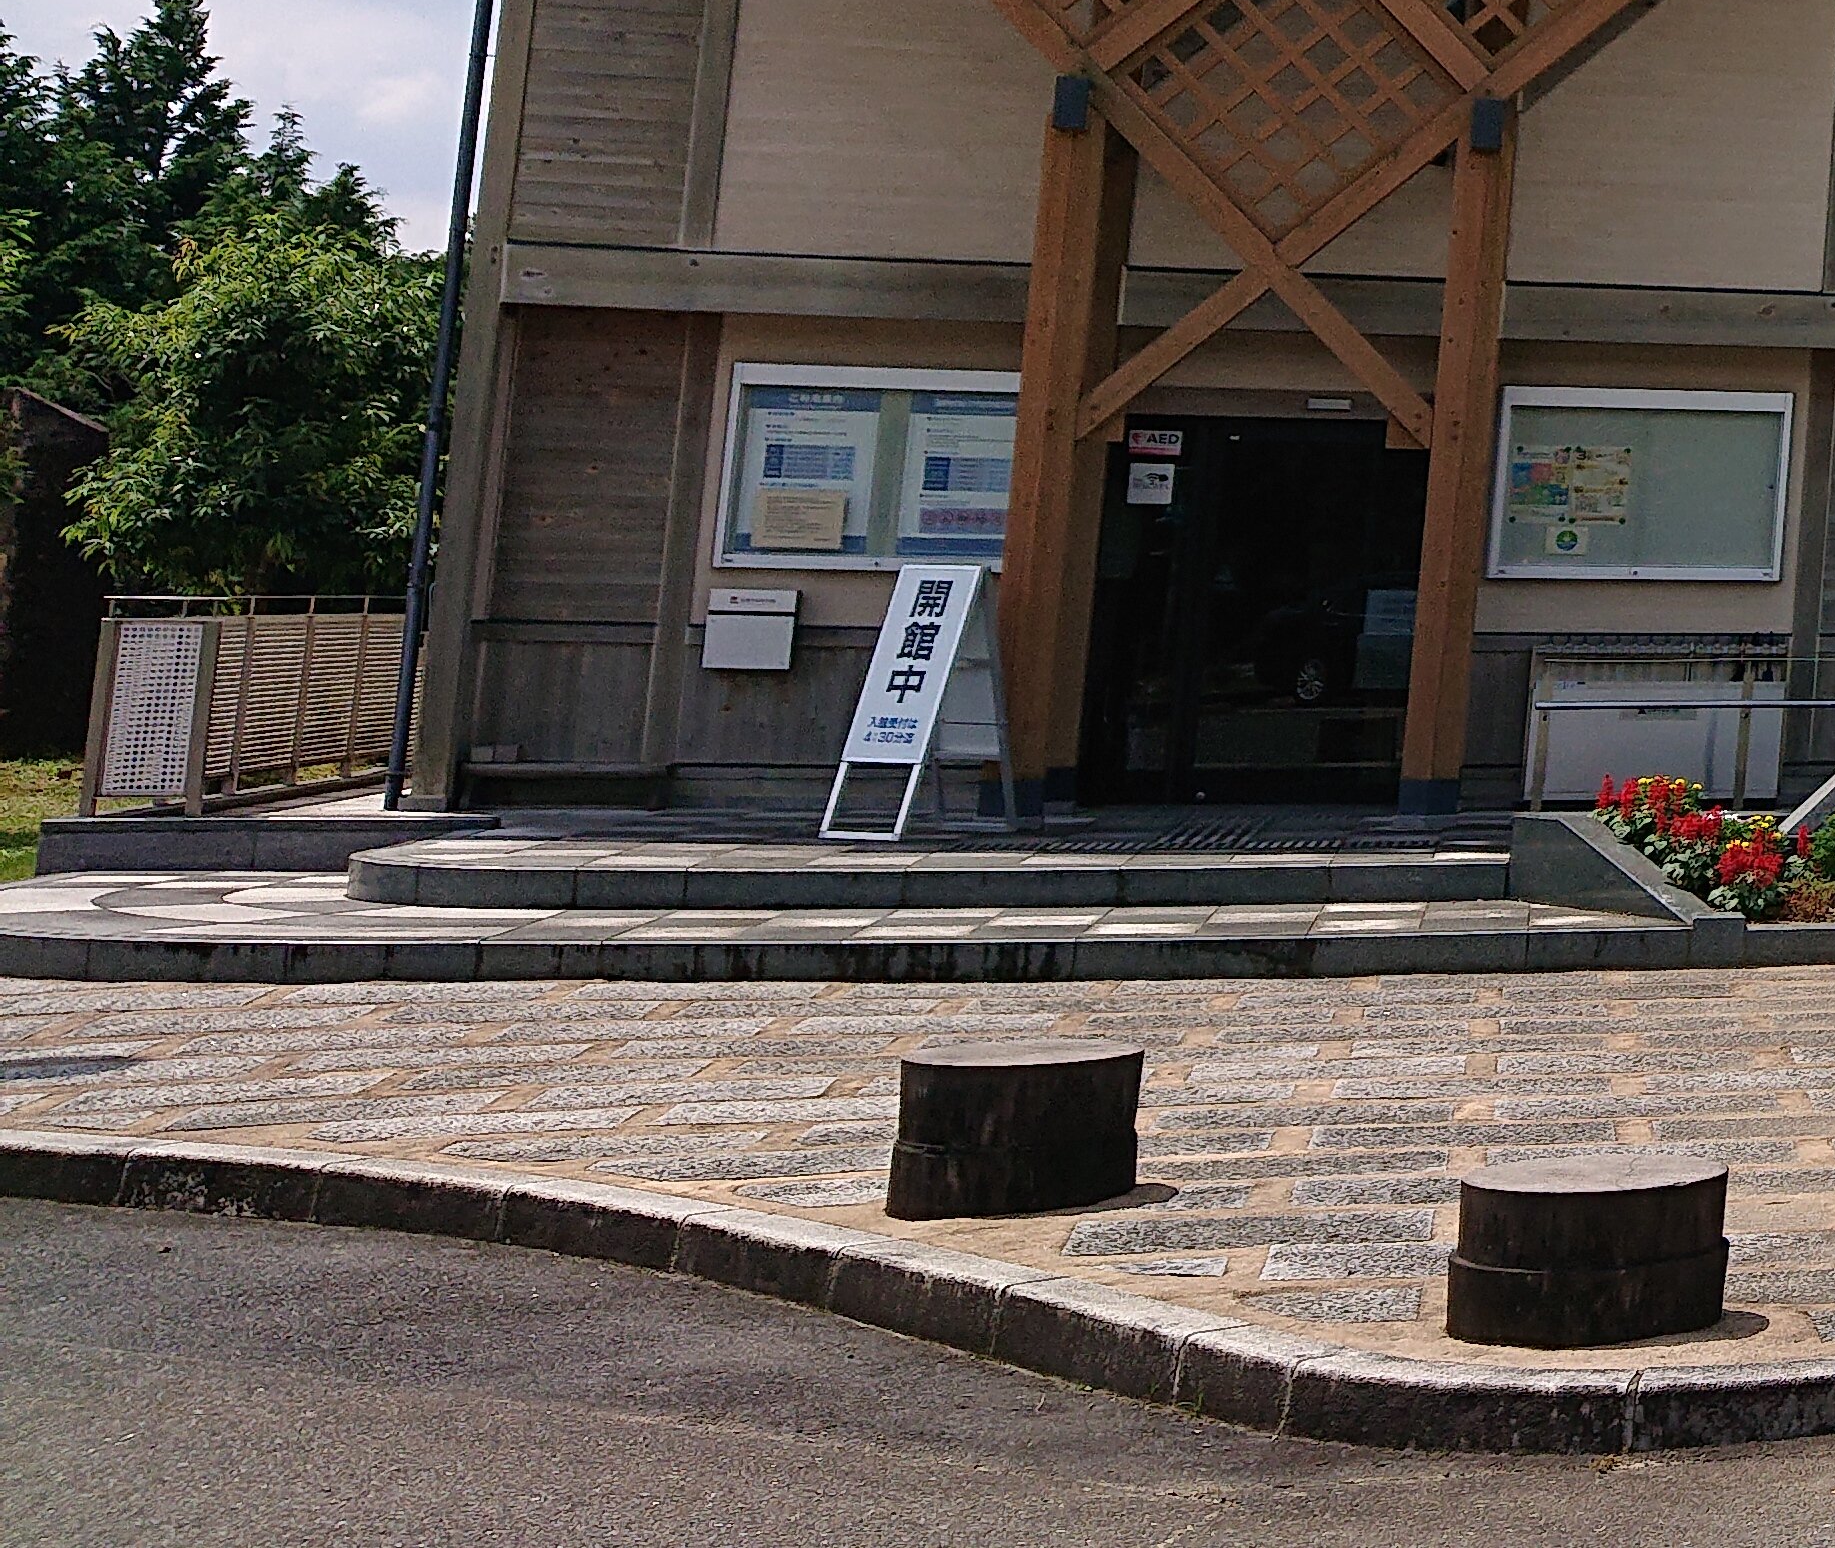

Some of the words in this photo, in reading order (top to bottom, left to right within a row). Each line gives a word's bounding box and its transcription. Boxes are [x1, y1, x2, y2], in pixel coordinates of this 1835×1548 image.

[1147, 433, 1180, 445] AED
[886, 580, 954, 704] 開館中
